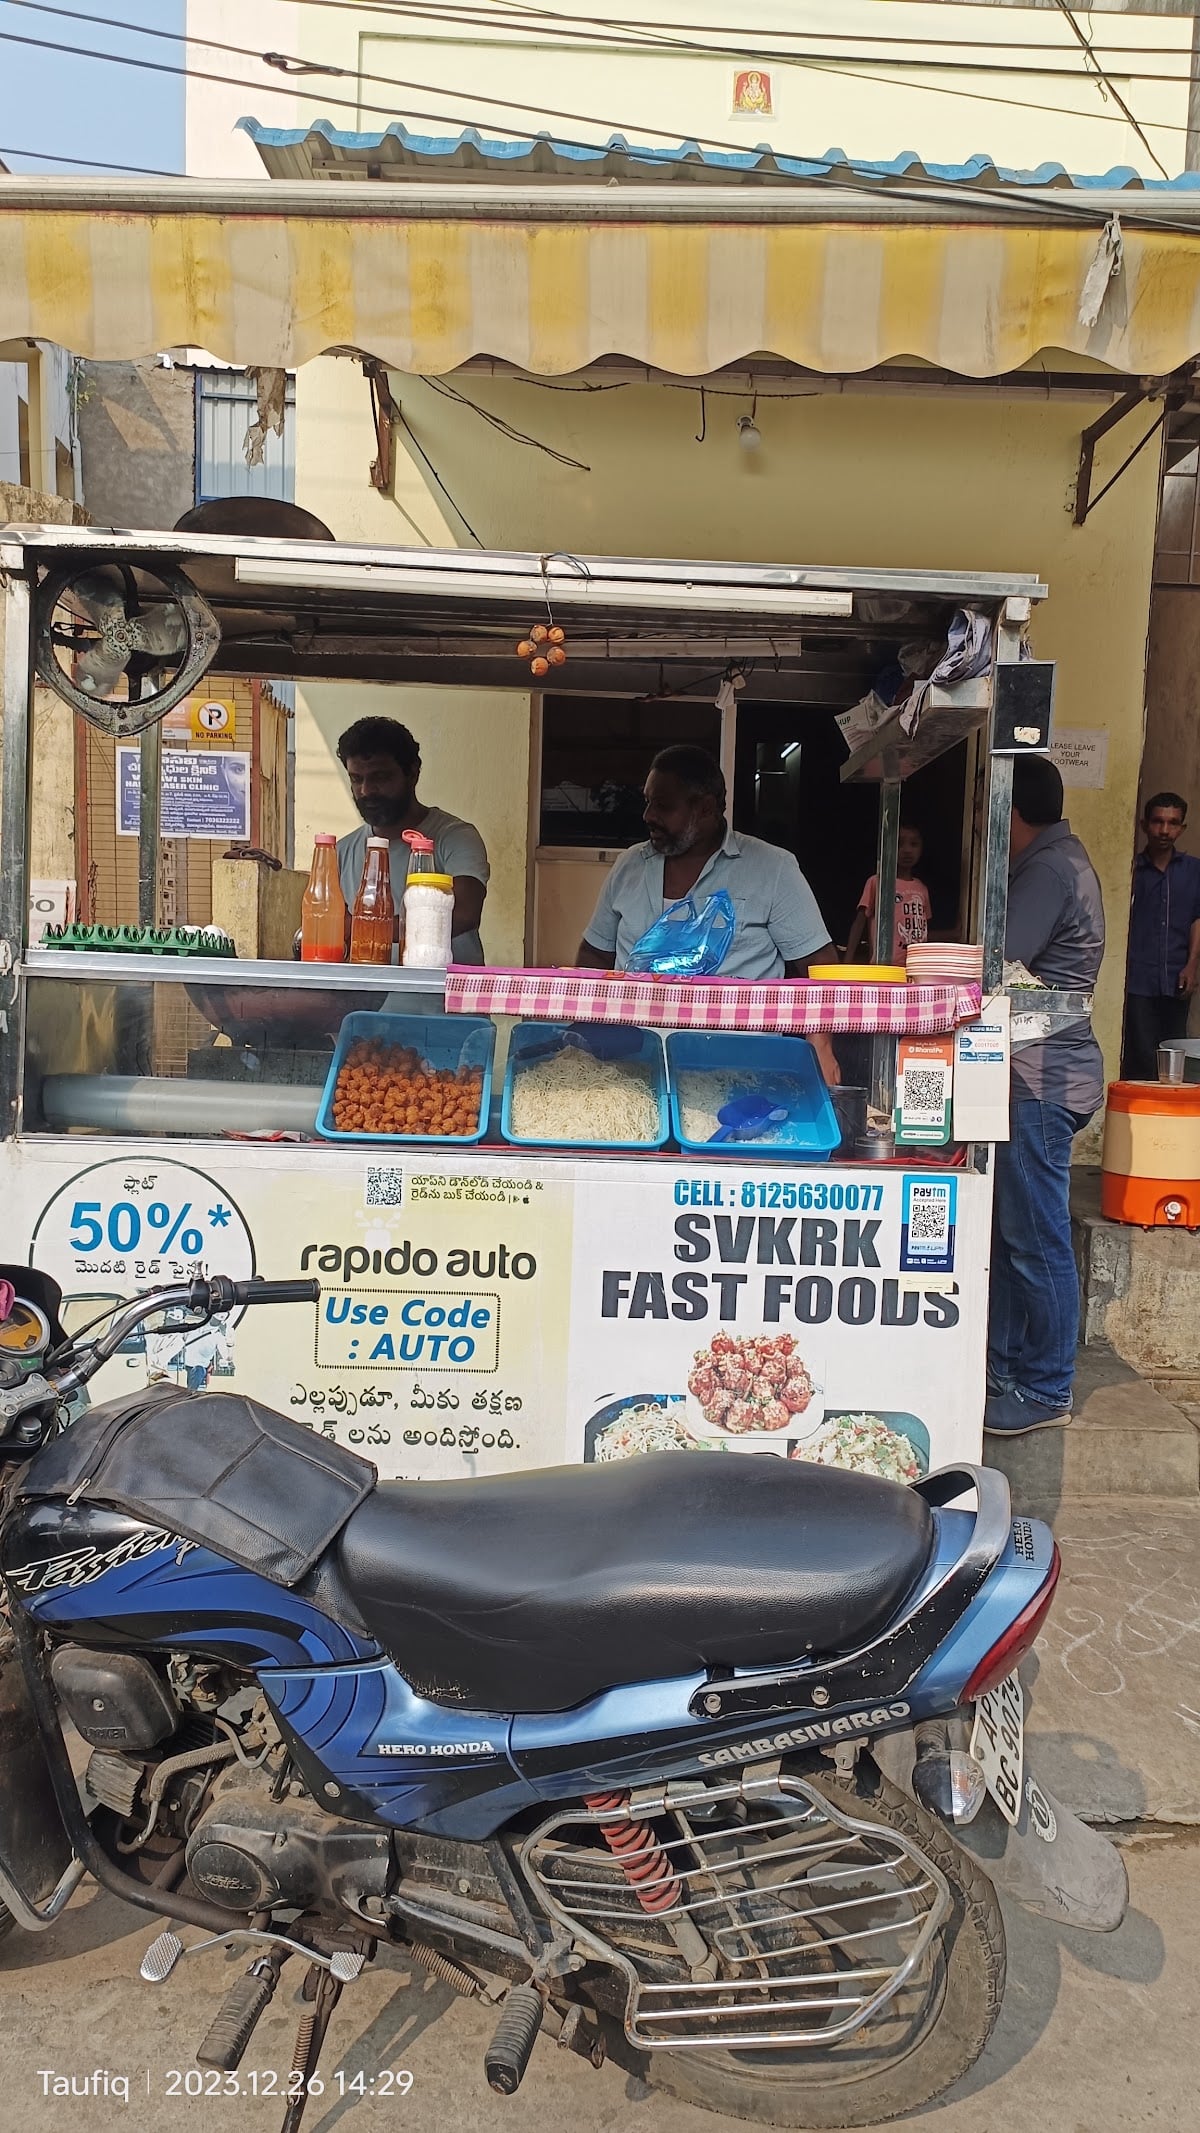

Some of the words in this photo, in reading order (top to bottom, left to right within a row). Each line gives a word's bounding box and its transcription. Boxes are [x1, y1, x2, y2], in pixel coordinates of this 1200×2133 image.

[206, 732, 233, 740] PARKING
[1050, 742, 1073, 750] LEASE
[1074, 744, 1096, 752] LEAVE
[1060, 750, 1081, 758] YOUR
[180, 776, 203, 784] SKIN
[741, 1181, 884, 1212] 8125630077
[673, 1213, 882, 1268] SVKRK
[74, 1259, 127, 1275] మొదటి
[134, 1260, 161, 1279] రైడ్
[300, 1240, 439, 1283] rapido
[445, 1243, 538, 1280] auto
[324, 1296, 389, 1326] Use
[400, 1299, 492, 1329] Code
[601, 1270, 748, 1320] FAST
[763, 1275, 961, 1328] FOODS
[368, 1333, 476, 1363] AUTO
[410, 1384, 460, 1410] మీకు
[471, 1390, 523, 1415] తక్షణ
[348, 1423, 391, 1446] లను
[1012, 1521, 1024, 1556] HERO
[378, 1744, 427, 1755] HERO
[430, 1740, 495, 1756] HONDA
[697, 1701, 911, 1768] SAMBASIVARAO
[995, 1754, 1019, 1816] BC
